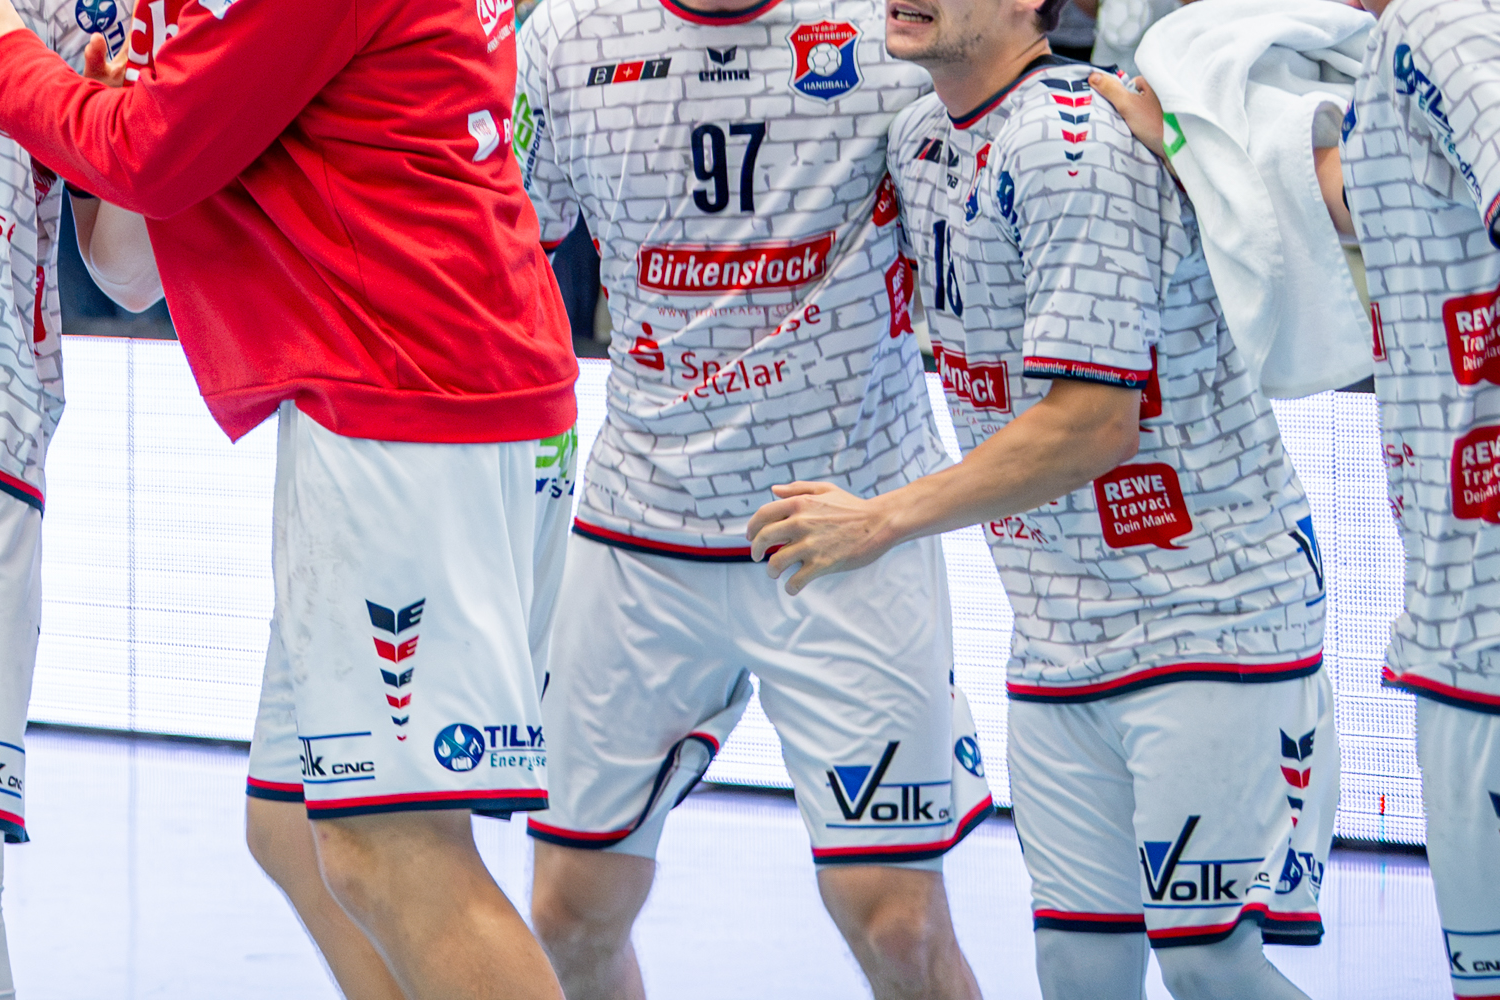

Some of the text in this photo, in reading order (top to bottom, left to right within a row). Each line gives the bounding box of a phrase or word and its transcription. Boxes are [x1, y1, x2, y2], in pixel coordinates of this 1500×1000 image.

[803, 79, 850, 91] HANDBALL
[690, 121, 766, 214] 97
[647, 246, 819, 286] Birkenstock
[1104, 473, 1166, 503] REWE
[1108, 493, 1172, 521] Travaci
[1113, 511, 1177, 536] Dein Markt
[331, 761, 375, 776] CNC
[826, 740, 933, 821] Volk
[1140, 815, 1238, 901] Volk
